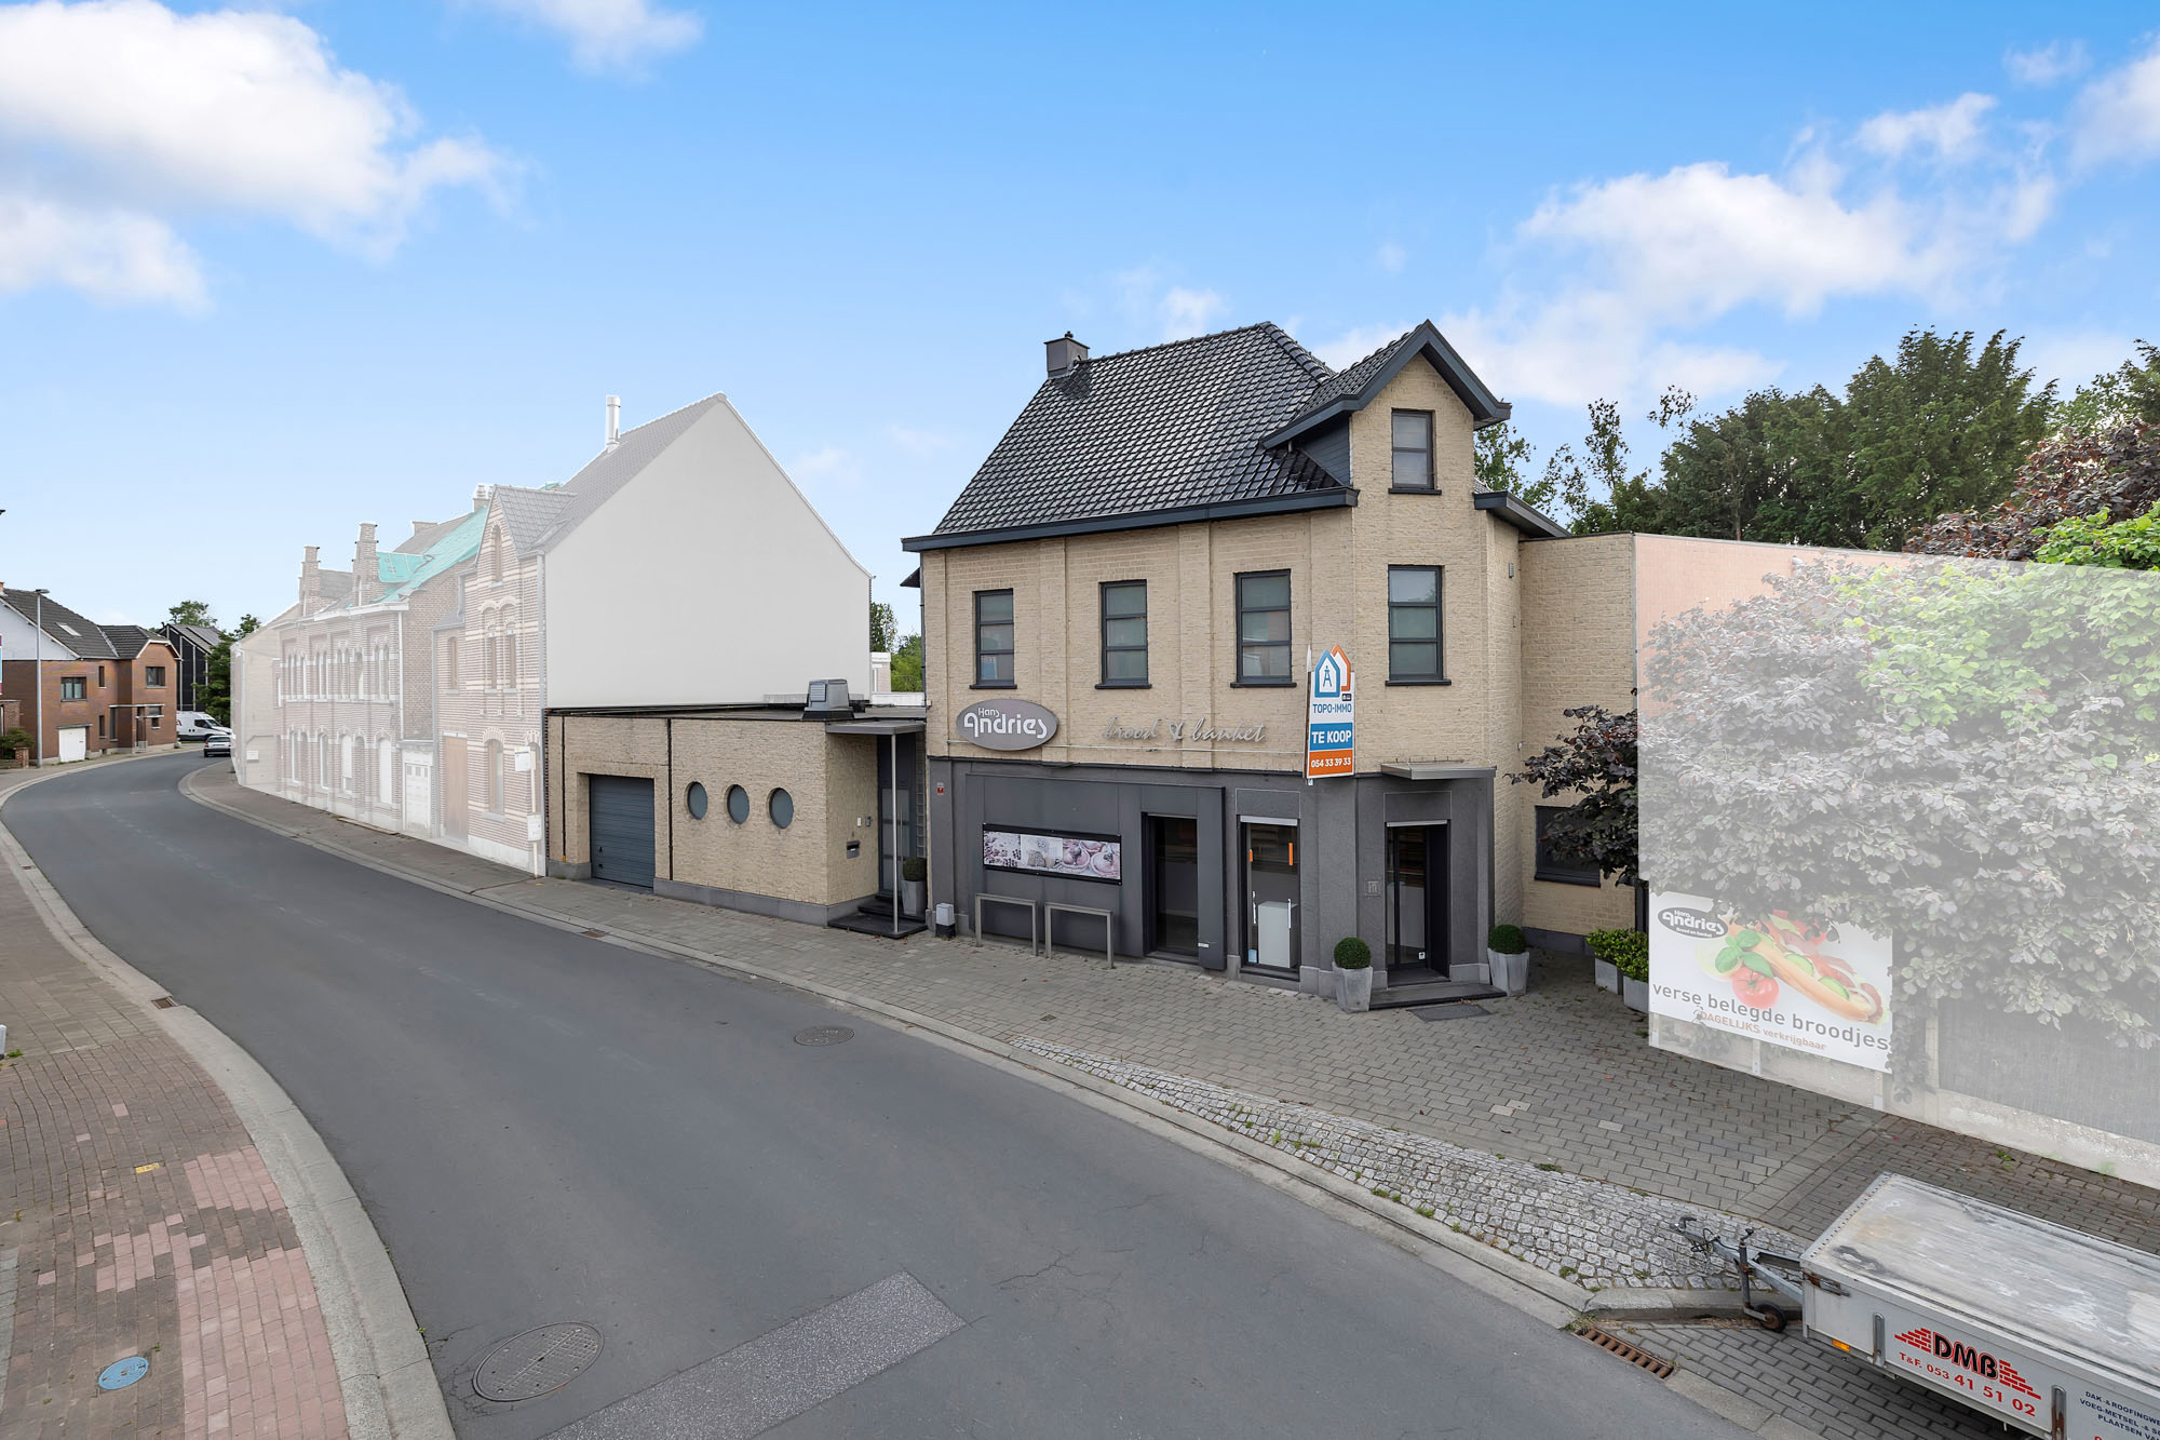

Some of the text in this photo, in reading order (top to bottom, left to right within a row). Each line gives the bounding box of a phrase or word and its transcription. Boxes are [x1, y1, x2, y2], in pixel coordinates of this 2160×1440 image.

[978, 707, 1000, 717] Hans
[1312, 703, 1353, 714] TOPO-IMMO
[963, 712, 1048, 739] Andries
[1102, 716, 1162, 741] brood
[1191, 716, 1267, 743] banket
[1311, 729, 1352, 744] TE KOOP
[1311, 756, 1352, 769] 054 33 39 33
[1662, 911, 1725, 936] Andries
[1652, 983, 1890, 1052] verse belegde broodjes
[1699, 1009, 1828, 1051] DAGELIJKS verkrijgbaar
[1933, 1332, 1999, 1381] DMB
[1926, 1363, 1950, 1380] 053
[1954, 1374, 1974, 1391] 41
[1983, 1385, 2003, 1403] 51
[2012, 1398, 2036, 1418] 02
[2085, 1391, 2102, 1403] DAK
[2098, 1414, 2143, 1437] PLAATSEN
